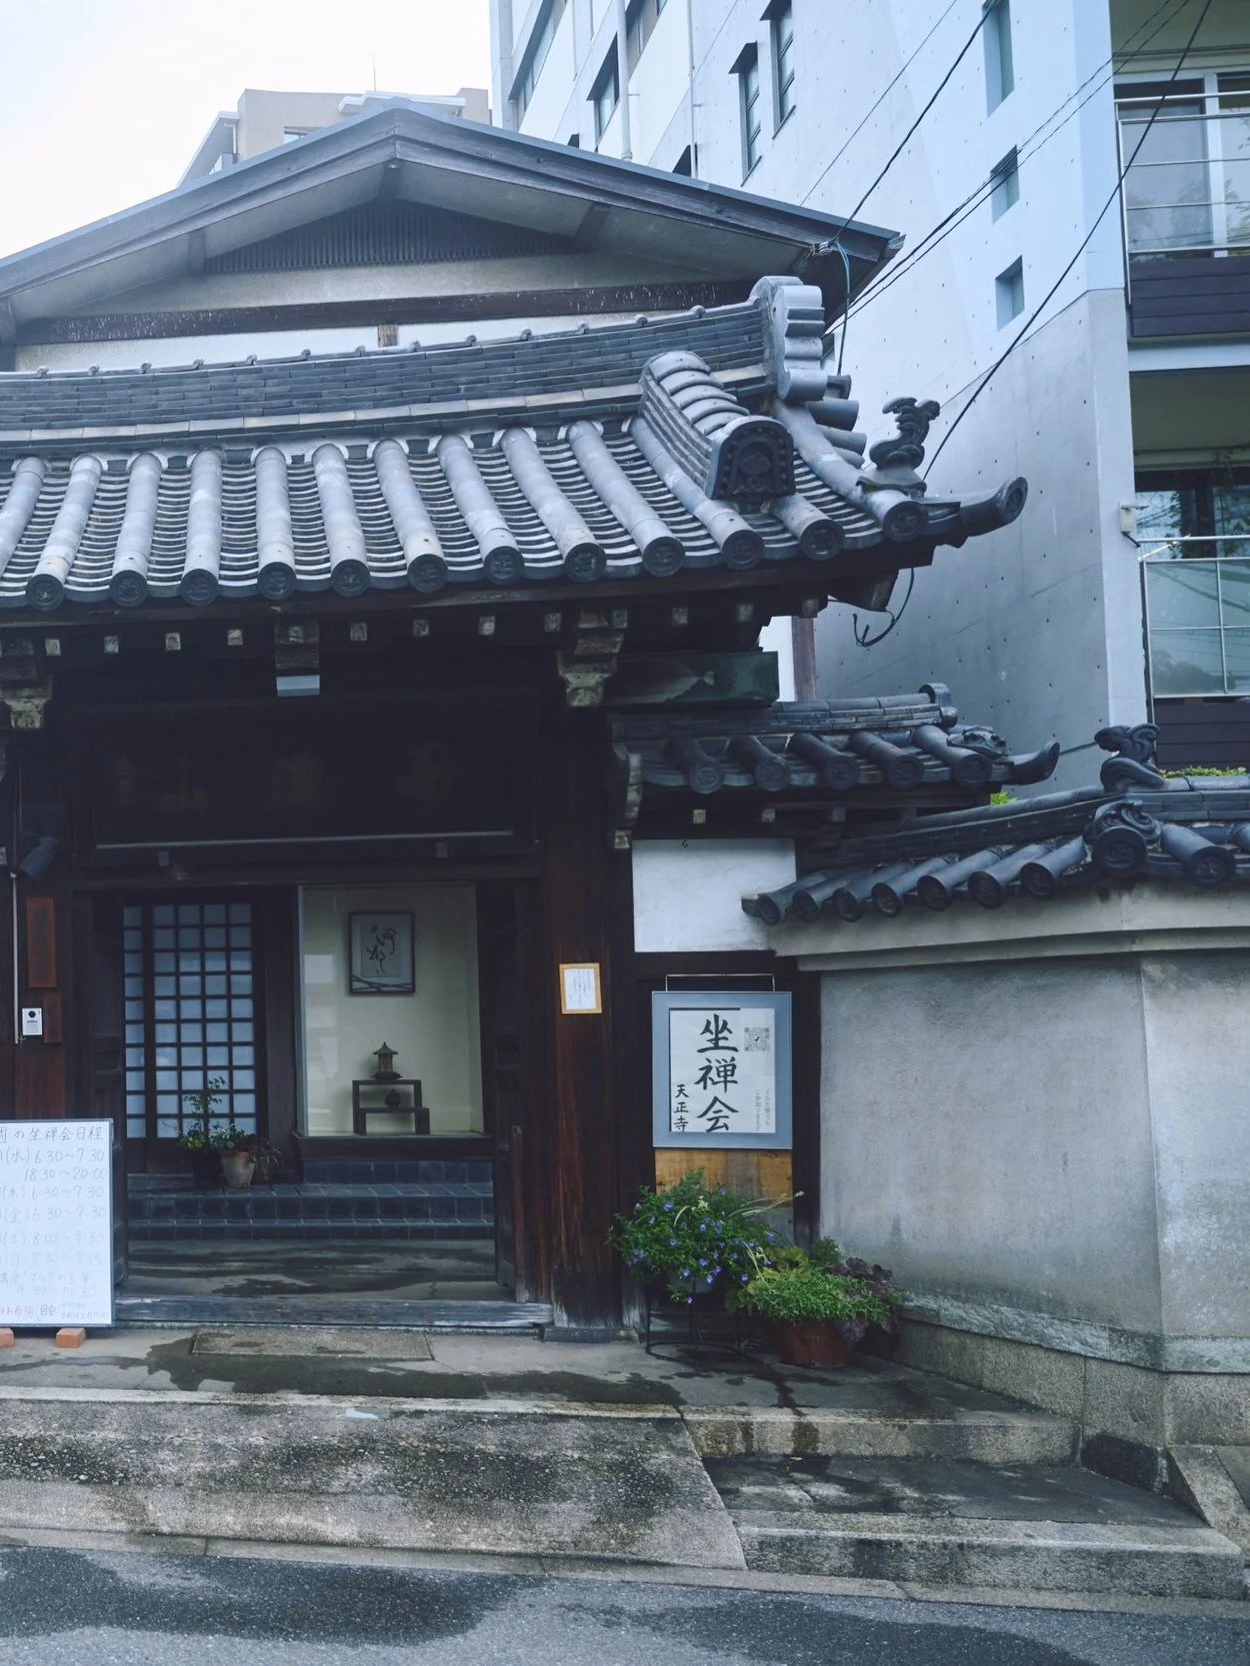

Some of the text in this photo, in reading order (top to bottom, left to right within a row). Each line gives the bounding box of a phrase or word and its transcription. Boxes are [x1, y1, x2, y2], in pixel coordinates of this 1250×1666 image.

[673, 1083, 689, 1132] 天正寺
[693, 1013, 740, 1133] 坐禅会
